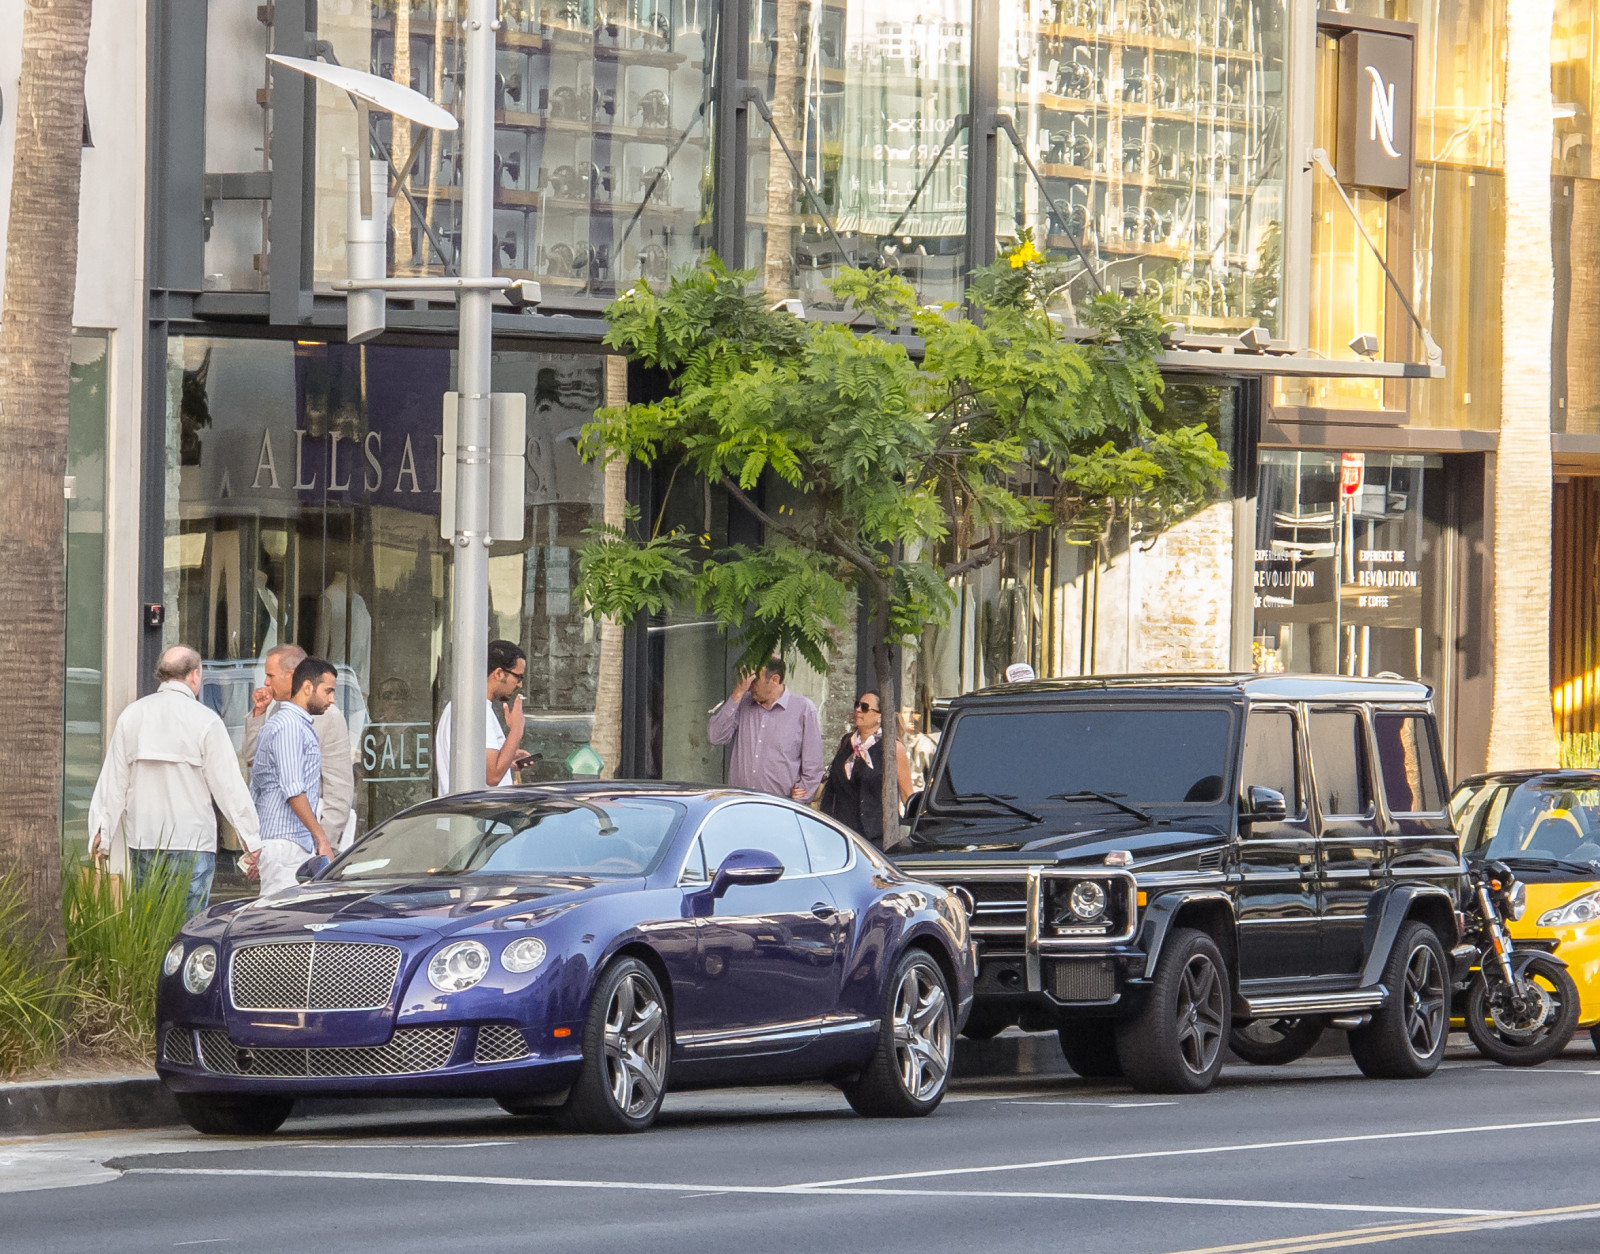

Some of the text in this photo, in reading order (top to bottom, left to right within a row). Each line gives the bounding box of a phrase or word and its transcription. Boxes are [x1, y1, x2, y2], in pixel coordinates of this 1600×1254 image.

[1365, 65, 1401, 157] N
[1359, 550, 1405, 562] EXPERIENCE THE
[1254, 570, 1315, 588] REVOLUTION
[1359, 569, 1417, 588] REVOLUTION
[1254, 596, 1262, 608] OF
[1359, 595, 1389, 607] OF COFFEE
[363, 733, 429, 771] SALE
